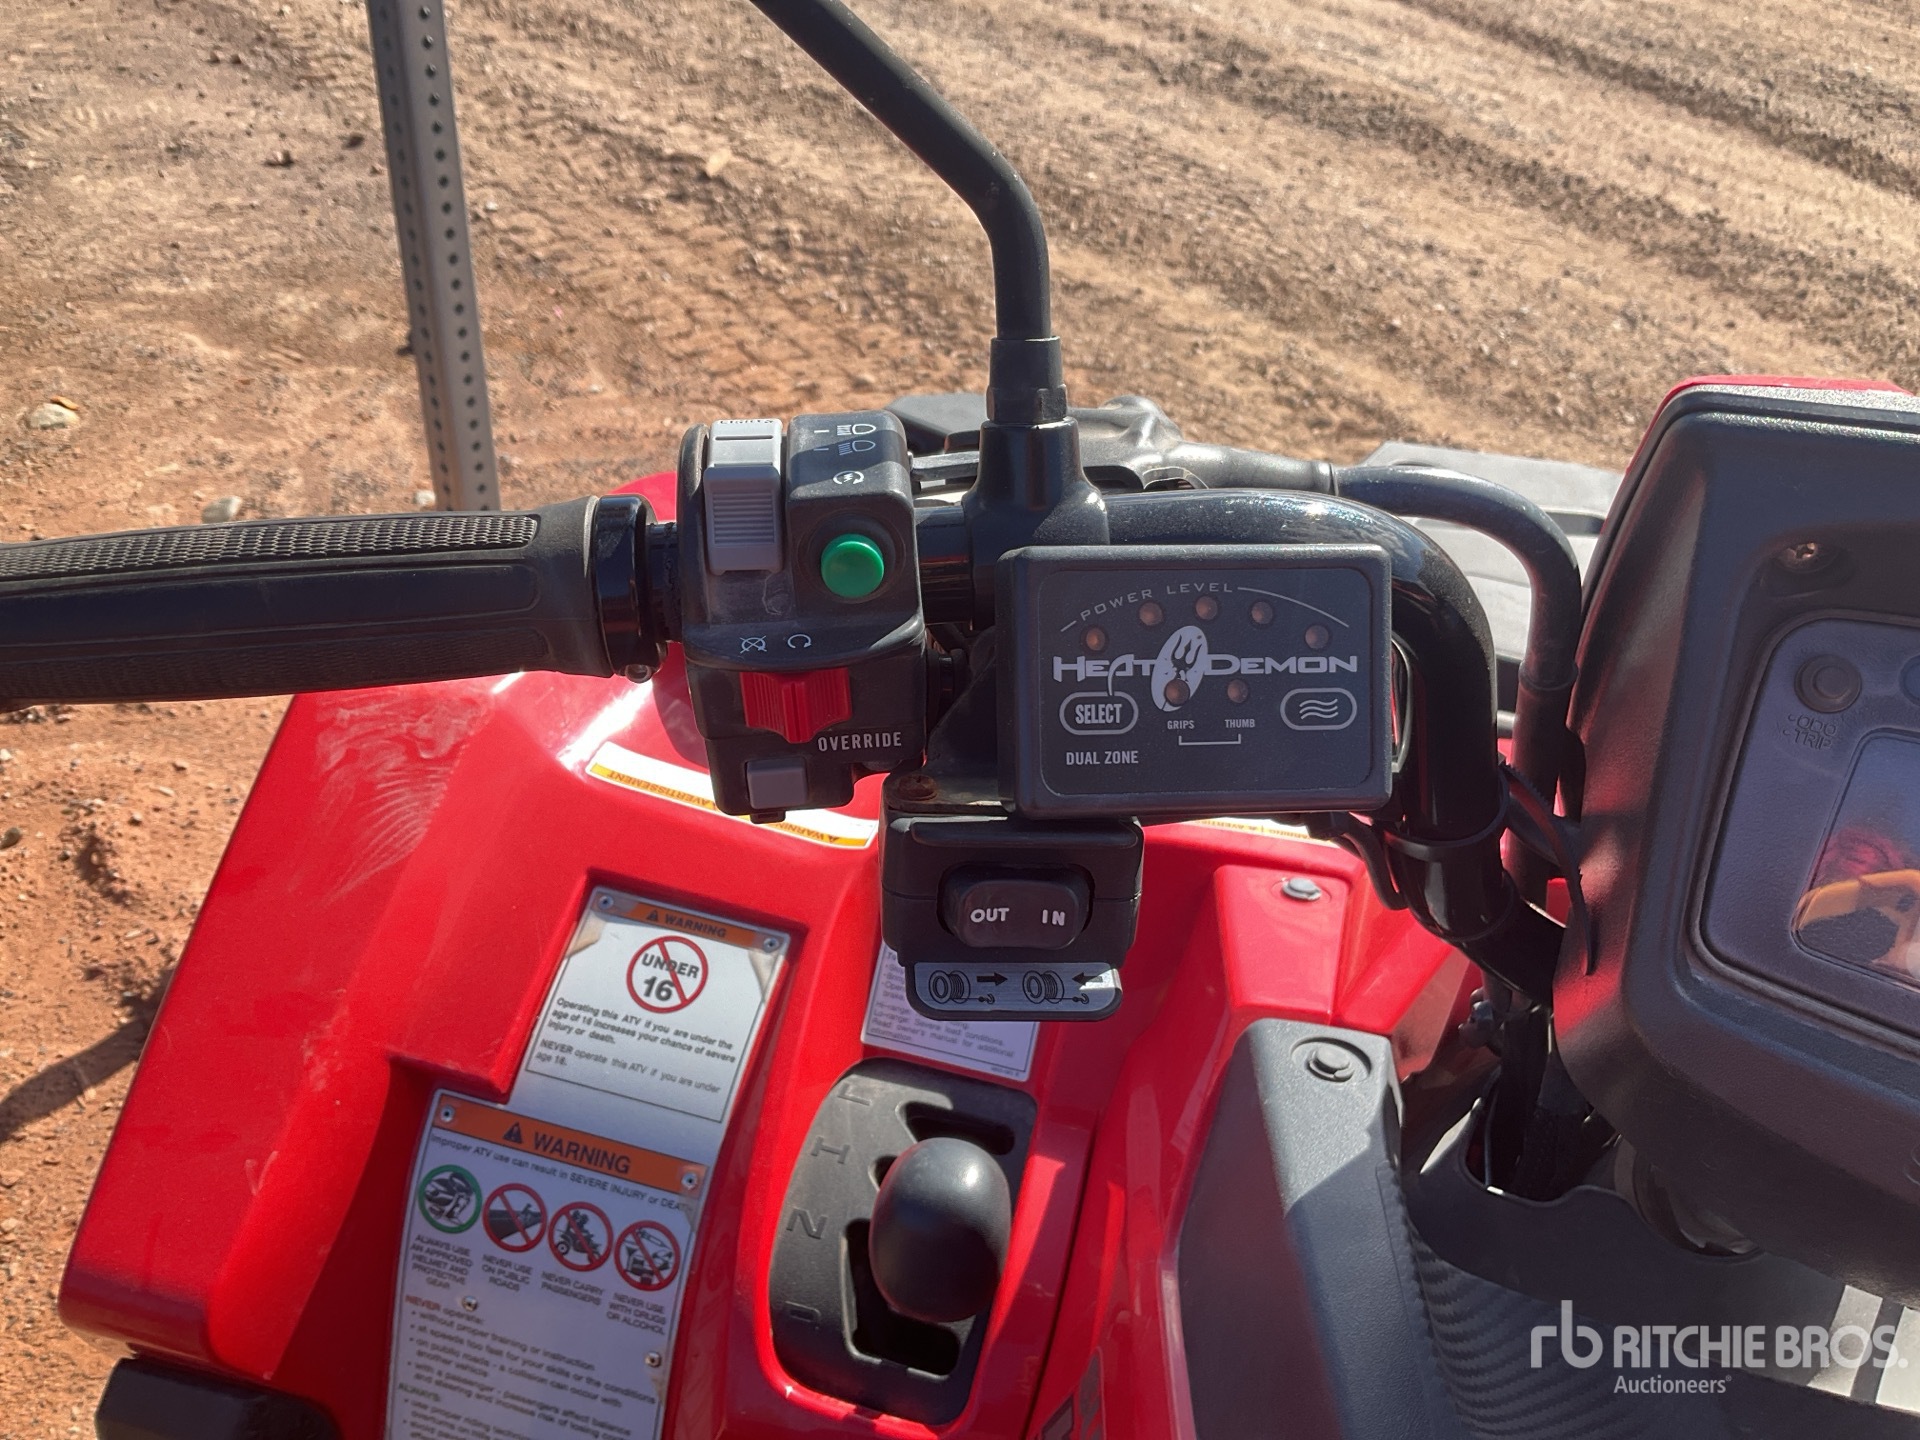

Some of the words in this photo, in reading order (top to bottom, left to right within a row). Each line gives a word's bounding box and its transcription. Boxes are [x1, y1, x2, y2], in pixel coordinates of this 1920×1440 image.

[1080, 589, 1153, 621] POWER
[1167, 583, 1233, 594] LEVEL
[1053, 653, 1158, 689] HEAT
[1204, 653, 1358, 675] DEMON
[1075, 704, 1122, 724] SELECT
[1167, 720, 1195, 730] GRIPS
[1224, 718, 1256, 728] THUMB
[818, 732, 902, 751] OVERRIDE
[1066, 751, 1101, 765] DUAL
[1104, 750, 1139, 765] ZONE
[664, 913, 727, 938] WARNING
[970, 908, 1009, 923] OUT
[1042, 909, 1065, 926] IN
[641, 952, 699, 979] UNDER
[641, 974, 676, 1002] 16
[622, 1013, 641, 1025] ATV
[534, 1131, 632, 1175] WARNING
